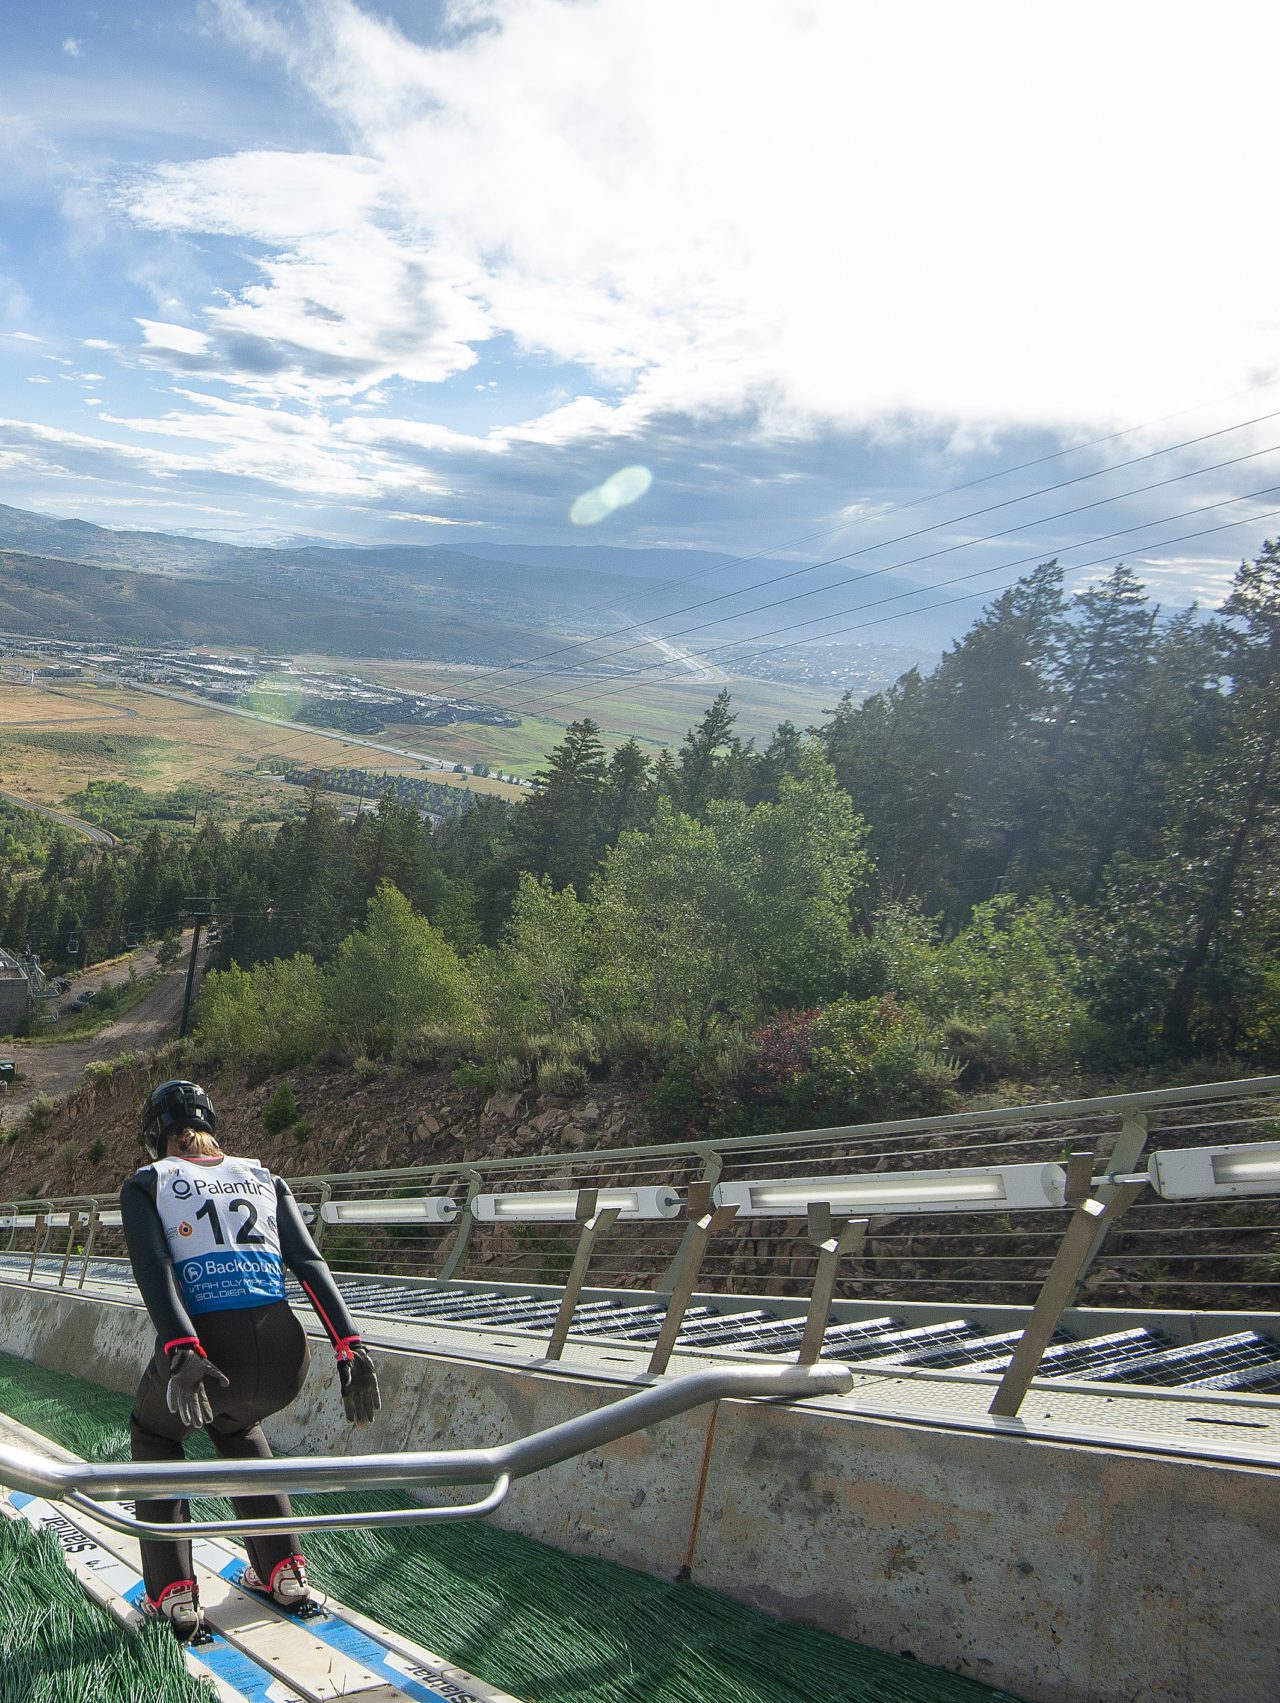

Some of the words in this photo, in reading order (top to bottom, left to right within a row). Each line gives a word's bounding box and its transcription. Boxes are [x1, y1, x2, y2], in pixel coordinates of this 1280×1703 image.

[193, 1179, 263, 1196] Palantir
[196, 1199, 265, 1245] 12
[189, 1281, 219, 1293] UTAH
[195, 1288, 247, 1301] SOLDIER
